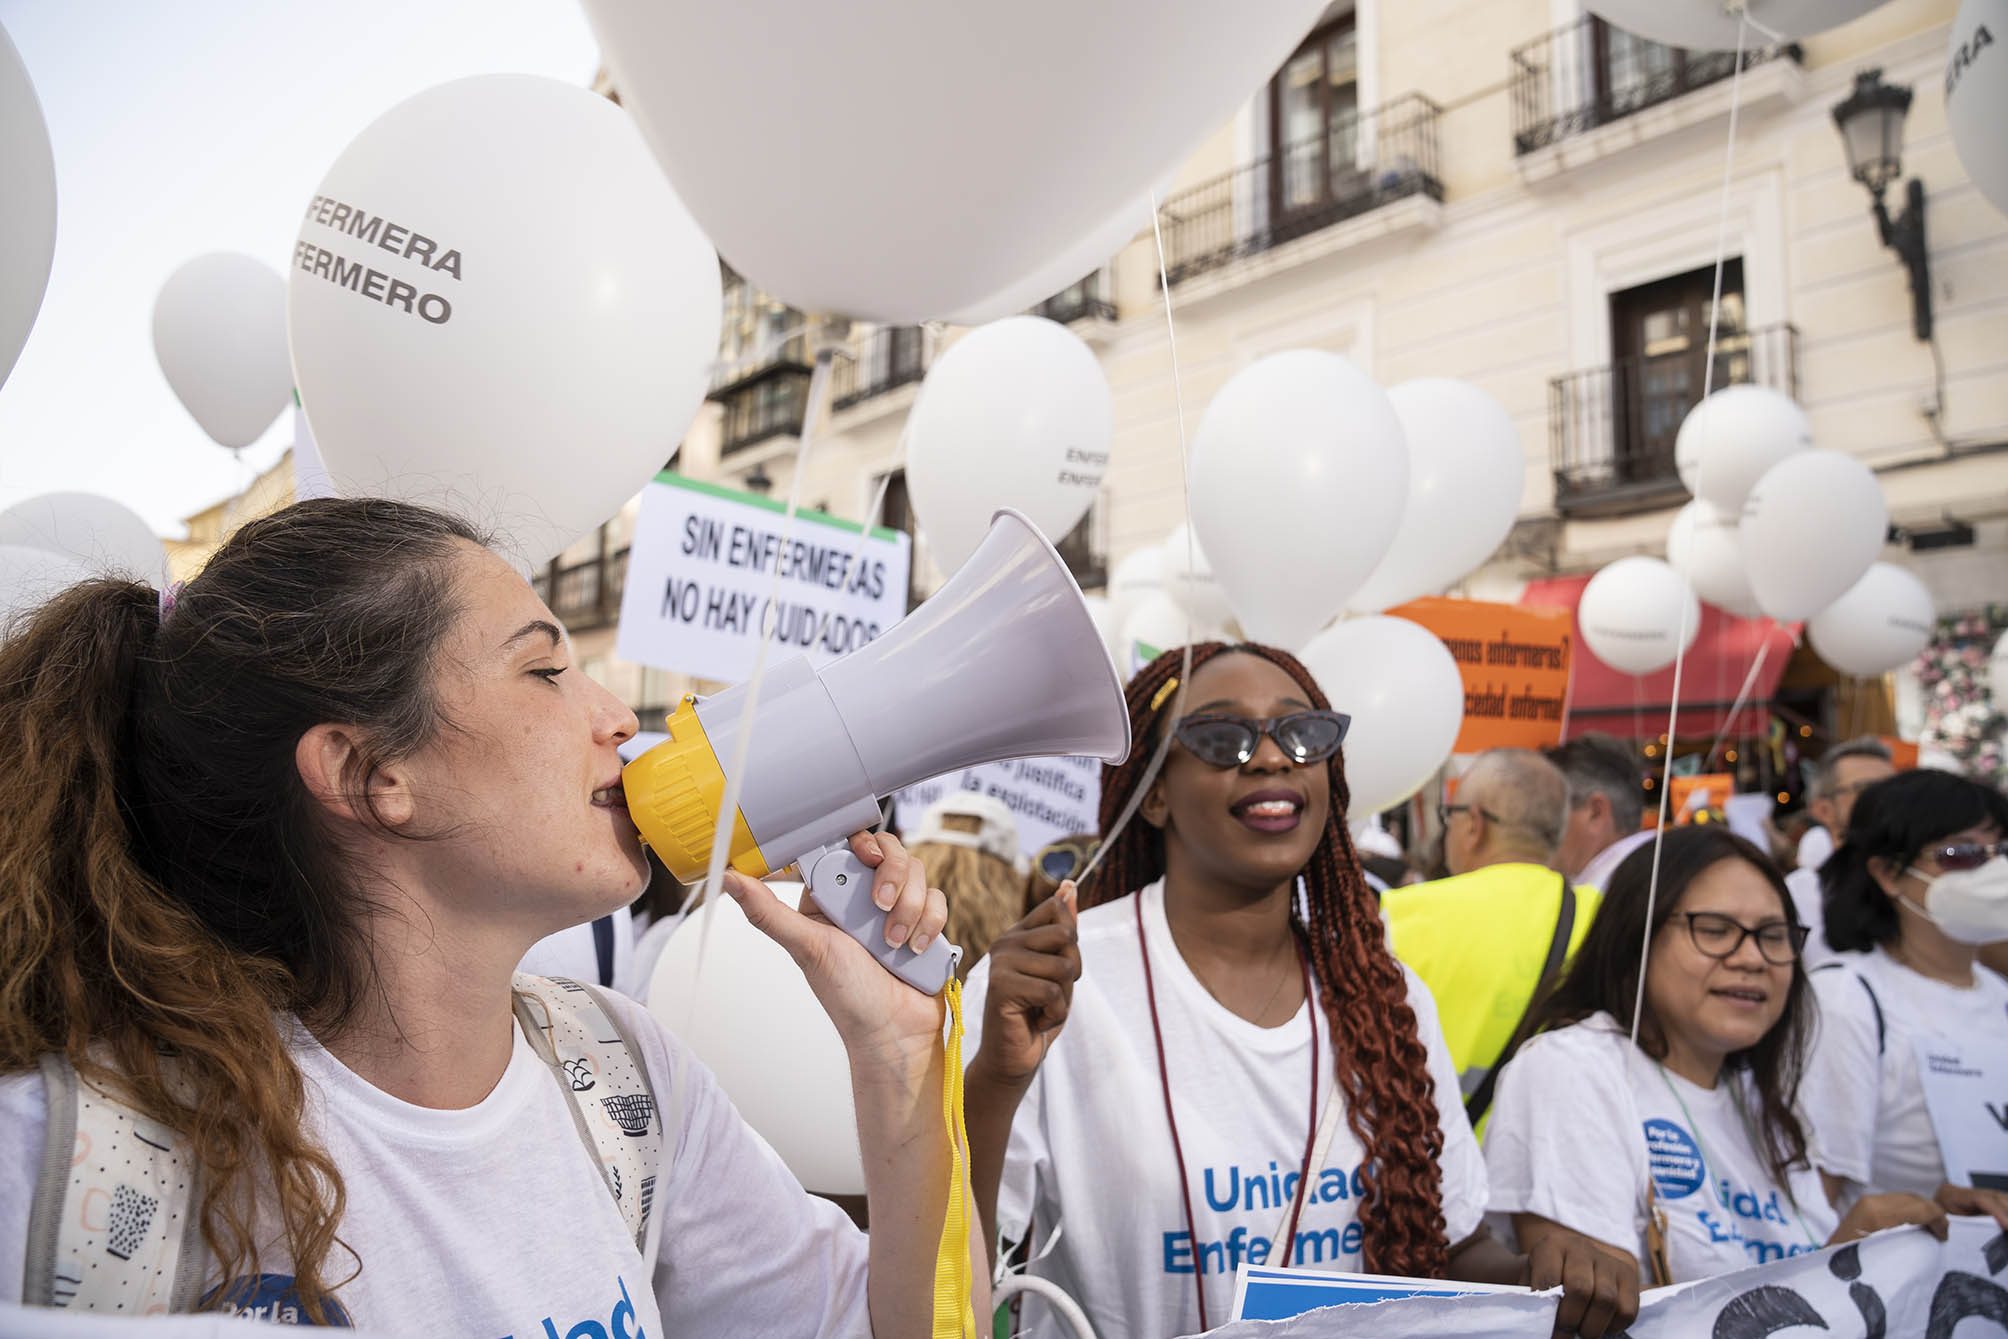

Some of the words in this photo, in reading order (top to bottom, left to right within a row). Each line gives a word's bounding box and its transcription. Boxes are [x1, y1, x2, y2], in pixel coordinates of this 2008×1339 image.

[682, 514, 724, 562] SIN
[728, 525, 887, 600] ENFERMERAS
[660, 575, 699, 623] NO
[704, 586, 756, 635] HAY
[1013, 759, 1087, 804] justifica
[1162, 1221, 1364, 1275] Enfeme
[271, 1300, 299, 1325] la
